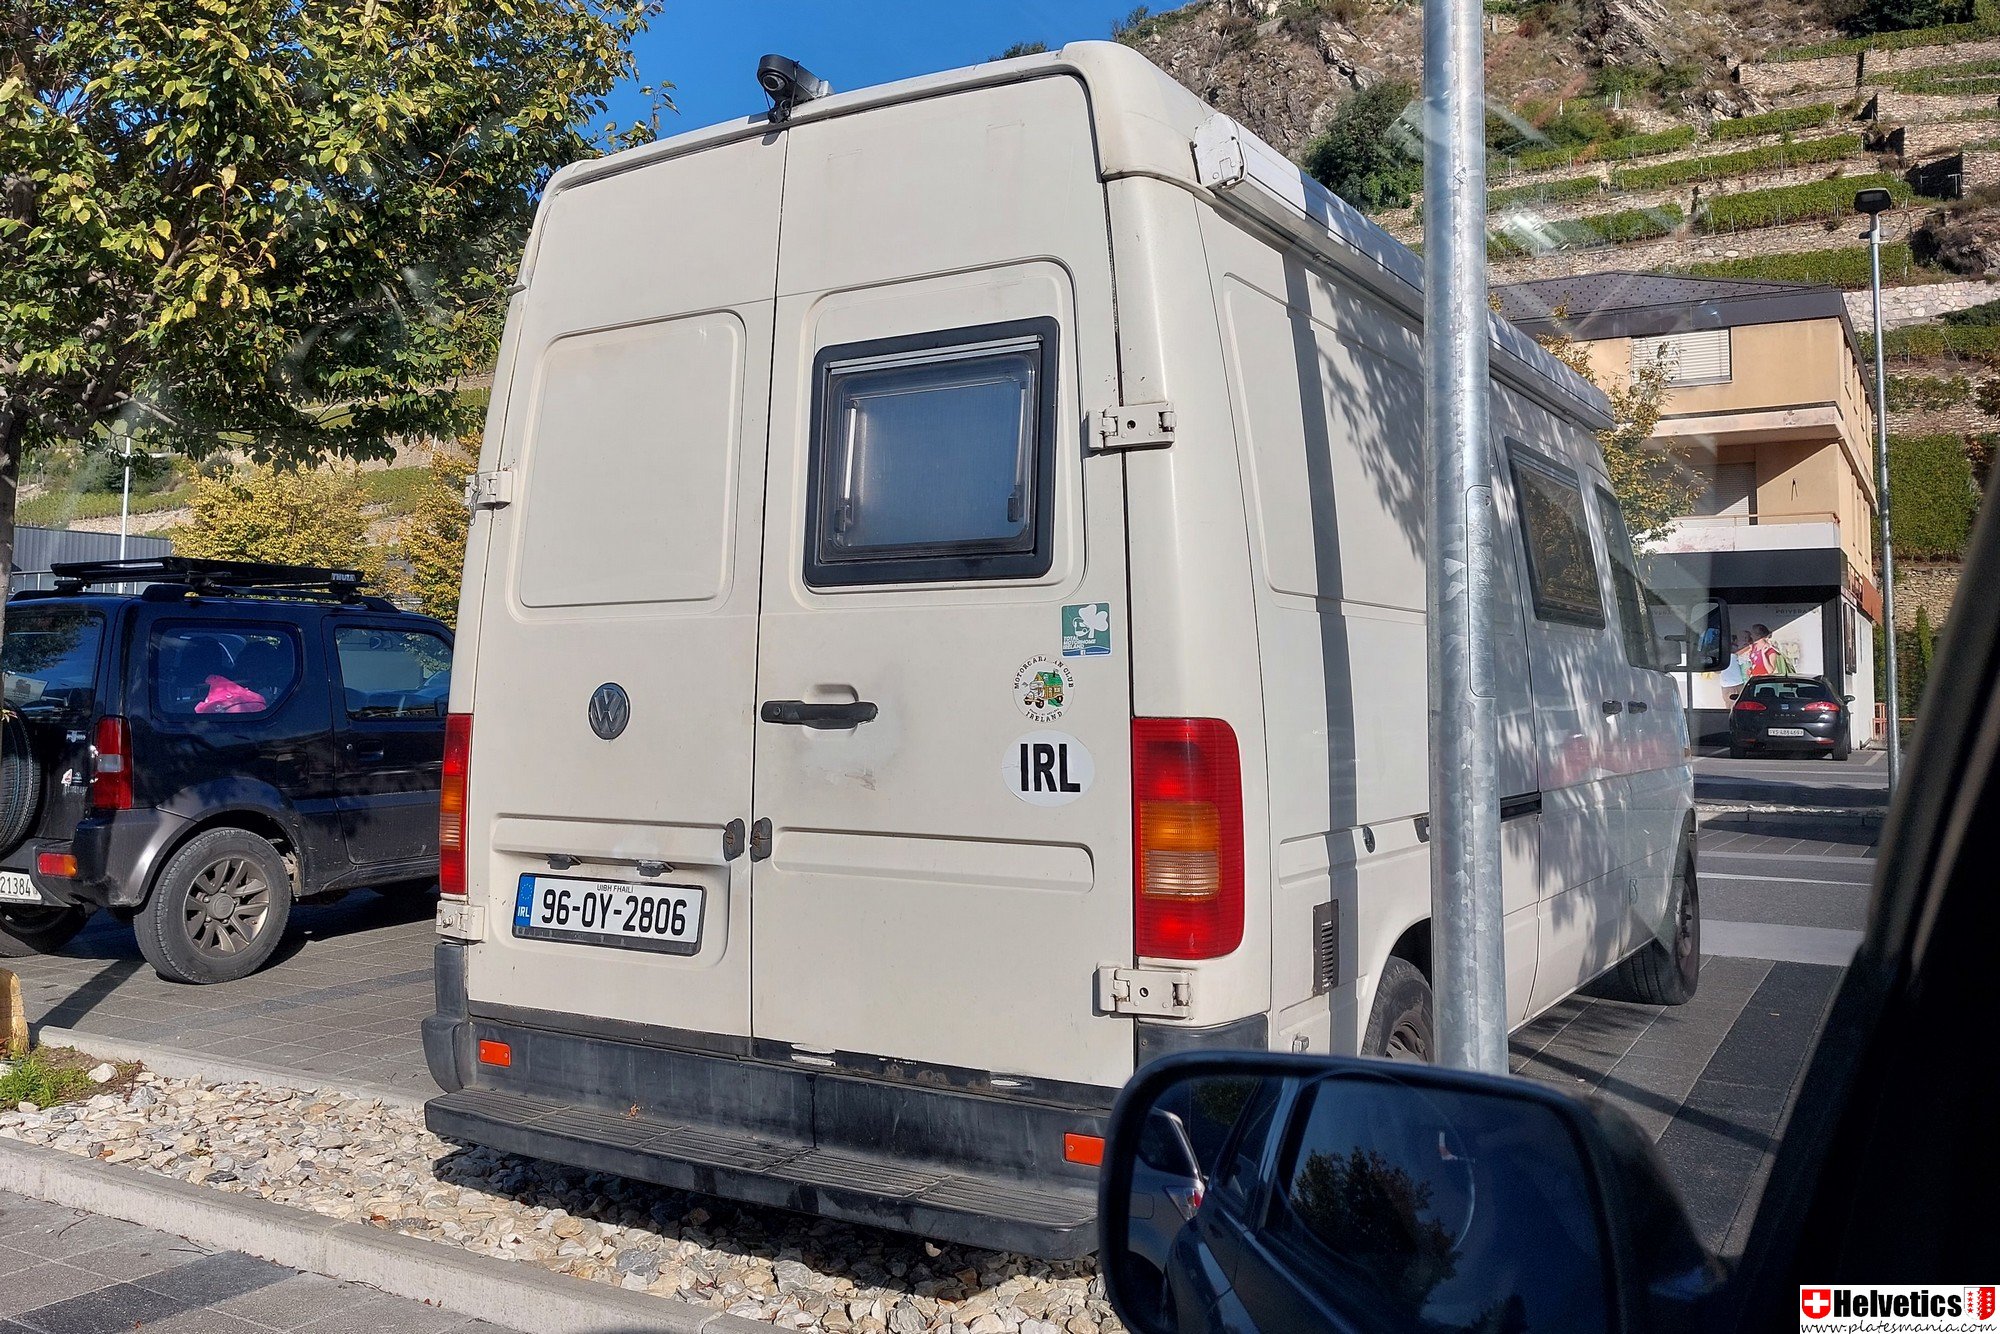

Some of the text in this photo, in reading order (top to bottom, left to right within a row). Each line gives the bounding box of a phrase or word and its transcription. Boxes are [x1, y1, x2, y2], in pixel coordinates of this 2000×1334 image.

[1025, 710, 1063, 723] IRELAND
[1020, 743, 1081, 792] IRL
[517, 906, 530, 918] IRL
[541, 888, 688, 936] 96-OY-2806
